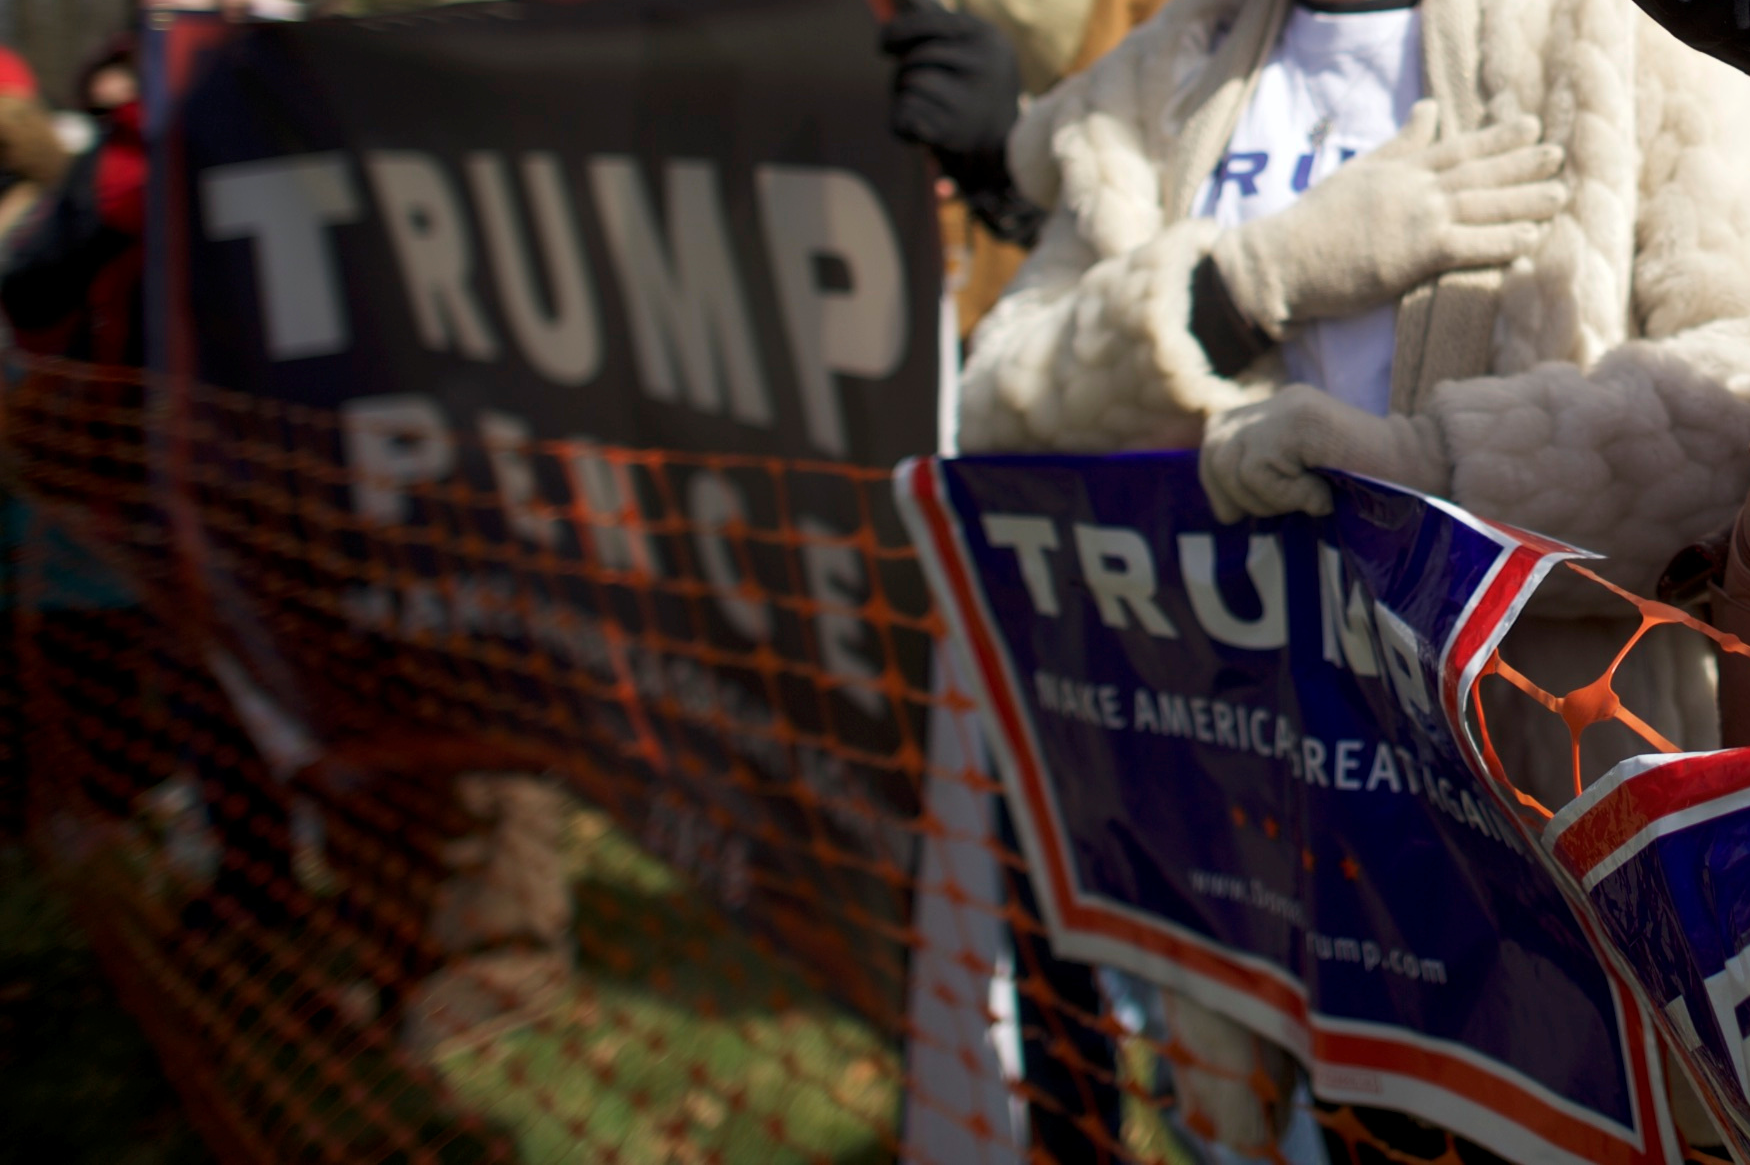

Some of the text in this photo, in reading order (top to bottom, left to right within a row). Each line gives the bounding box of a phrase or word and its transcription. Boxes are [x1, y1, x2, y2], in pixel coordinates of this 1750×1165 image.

[202, 148, 909, 457] TRUMP
[1033, 667, 1128, 732] MAKE
[1132, 685, 1292, 761] AMERICA
[1287, 729, 1421, 796] REAT
